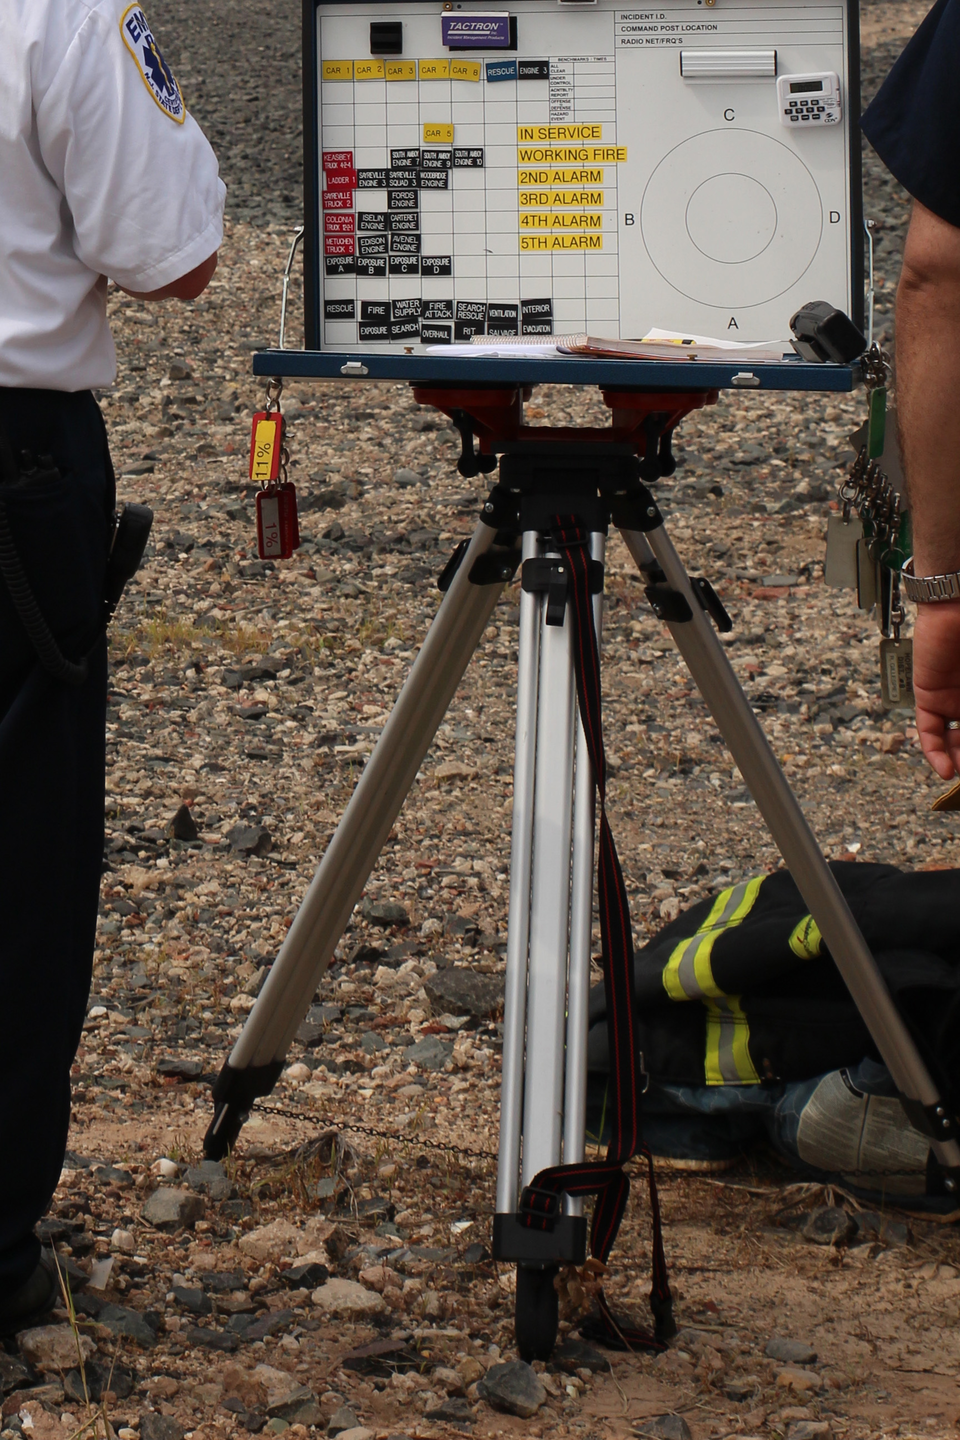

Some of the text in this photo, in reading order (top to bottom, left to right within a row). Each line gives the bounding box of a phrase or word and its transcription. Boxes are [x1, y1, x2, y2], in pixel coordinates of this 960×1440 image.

[449, 22, 499, 30] TACTRON
[356, 66, 372, 74] CAR
[387, 67, 403, 75] CAR
[421, 66, 437, 74] CAR
[452, 67, 467, 75] CAR
[487, 67, 515, 76] RESCUE
[520, 67, 539, 75] ENGINE
[724, 108, 735, 121] C
[426, 129, 441, 137] CAR
[520, 126, 600, 140] IN SERVICE
[520, 149, 625, 161] WORKING FIRE
[423, 160, 442, 168] ENGINE
[455, 158, 473, 166] ENGINE
[358, 171, 386, 179] SAYREVILLE
[520, 171, 601, 183] 2ND ALARM
[328, 176, 349, 184] LADDER
[359, 179, 379, 187] ENGINE
[389, 179, 409, 187] SQUAD
[323, 192, 351, 200] SAYREVILLE
[520, 193, 602, 205] 3RD ALARM
[324, 200, 343, 208] TRUCK
[391, 199, 415, 207] ENGINE
[362, 214, 384, 222] ISELIN
[521, 215, 601, 227] 4TH ALARM
[625, 214, 635, 226] B
[830, 211, 841, 224] D
[361, 222, 385, 230] ENGINE
[360, 237, 385, 246] EDISON
[521, 236, 601, 249] 5TH ALARM
[361, 245, 385, 254] ENGINE
[393, 243, 417, 251] ENGINE
[327, 257, 354, 265] EXPOSURE
[358, 259, 385, 267] EXPOSURE
[395, 300, 420, 308] WATER
[429, 302, 446, 310] FIRE
[458, 304, 485, 312] SEARCH
[327, 304, 354, 313] RESCUE
[368, 306, 385, 314] FIRE
[394, 308, 422, 317] SUPPLY
[522, 304, 550, 313] INTERIOR
[424, 310, 452, 318] ATTACK
[458, 312, 484, 320] RESCUE
[489, 310, 516, 318] VENTILATION
[727, 317, 739, 329] A
[361, 326, 388, 335] EXPOSURE
[391, 323, 419, 334] SEARCH
[463, 327, 476, 335] RIT
[523, 325, 551, 333] EVACUATION
[422, 330, 449, 339] OVERHAUL
[265, 522, 279, 548] 1%
